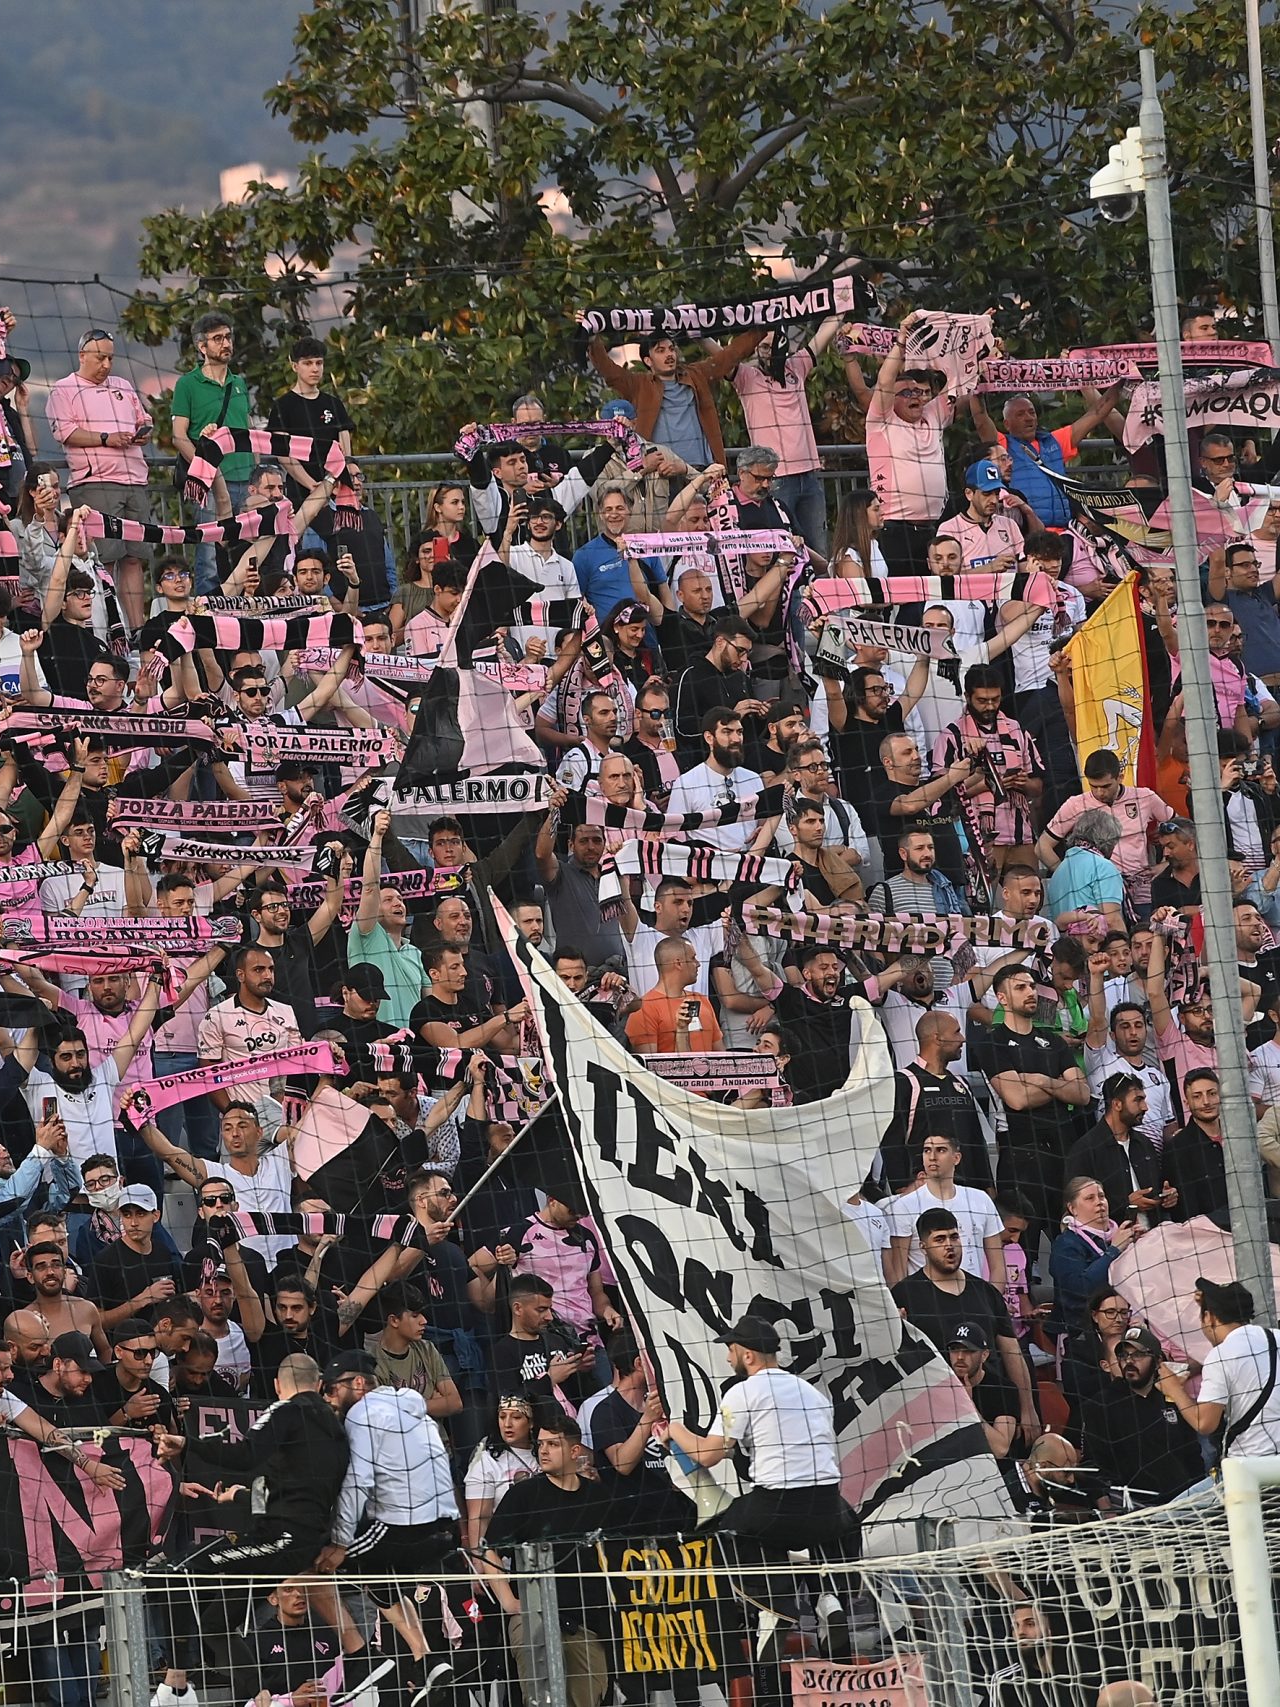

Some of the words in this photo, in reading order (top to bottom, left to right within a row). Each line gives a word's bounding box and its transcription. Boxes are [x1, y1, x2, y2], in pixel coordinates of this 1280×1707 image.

[610, 308, 655, 331] CHE
[661, 306, 717, 331] AMO
[863, 328, 900, 348] FOR
[988, 363, 1046, 383] FORZA
[1051, 358, 1130, 381] PALERMO
[209, 595, 252, 611] FORZA
[254, 594, 313, 610] PALERMO
[845, 620, 932, 654] PALERMO
[128, 718, 144, 733] TI
[148, 718, 187, 734] ODIO
[245, 734, 303, 750] FORZA
[308, 736, 384, 754] PALERMO
[395, 776, 532, 804] PALERMO
[119, 799, 184, 818] FORZA
[172, 843, 306, 863] #SIAMOAQUILE
[290, 884, 325, 904] FOR
[52, 916, 189, 930] INESORABILMENTE
[748, 907, 946, 950] PALERMO
[55, 928, 188, 942] ROSANERO
[210, 1060, 245, 1076] Solo
[248, 1046, 319, 1066] Palermo
[648, 1060, 694, 1077] FORZA
[708, 1057, 777, 1077] PALERMO
[924, 1096, 968, 1109] EUROBET
[645, 1460, 665, 1469] umb
[621, 1537, 718, 1606] SOLITI
[620, 1609, 718, 1674] IGNOTI
